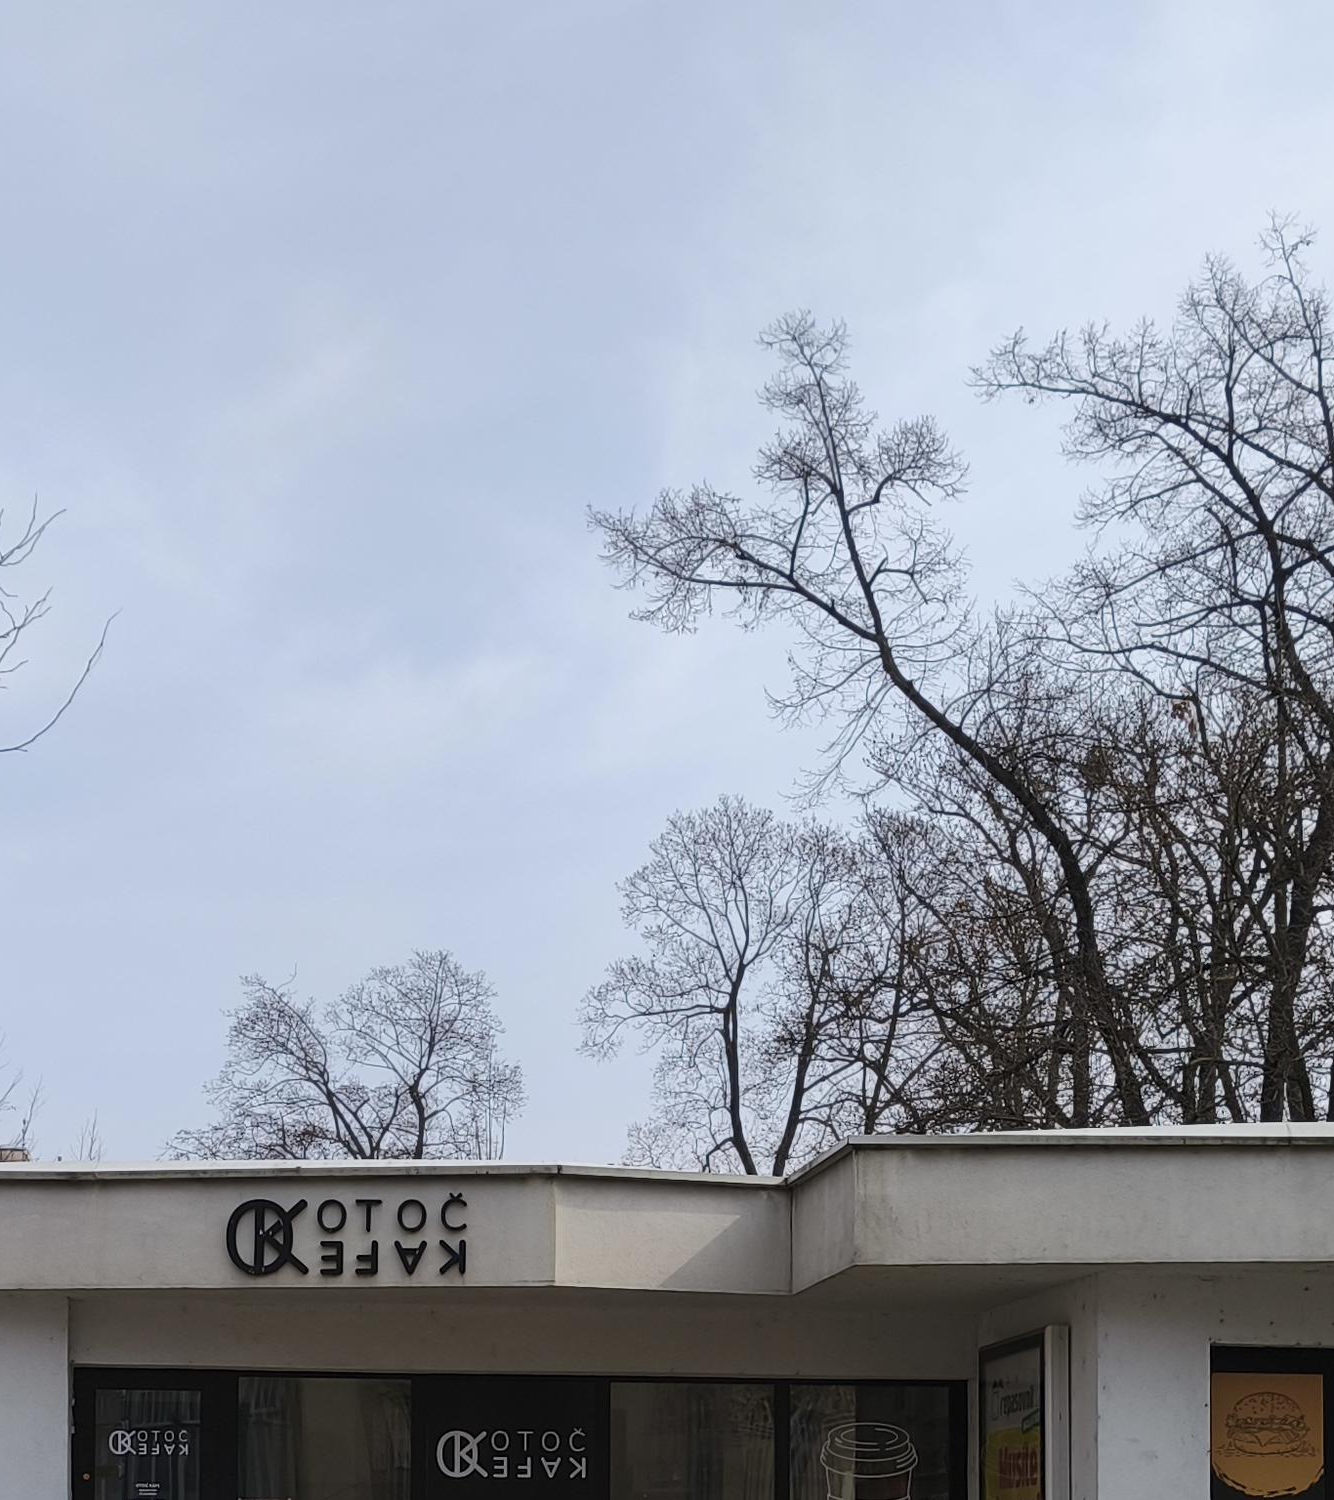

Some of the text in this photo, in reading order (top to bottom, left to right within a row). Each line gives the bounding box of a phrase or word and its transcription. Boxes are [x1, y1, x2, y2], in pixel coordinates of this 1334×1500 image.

[317, 1192, 468, 1233] OTOČ
[318, 1239, 467, 1276] KAFE
[138, 1443, 189, 1456] KAFE
[491, 1427, 586, 1452] OTOČ
[493, 1456, 587, 1479] KAFE
